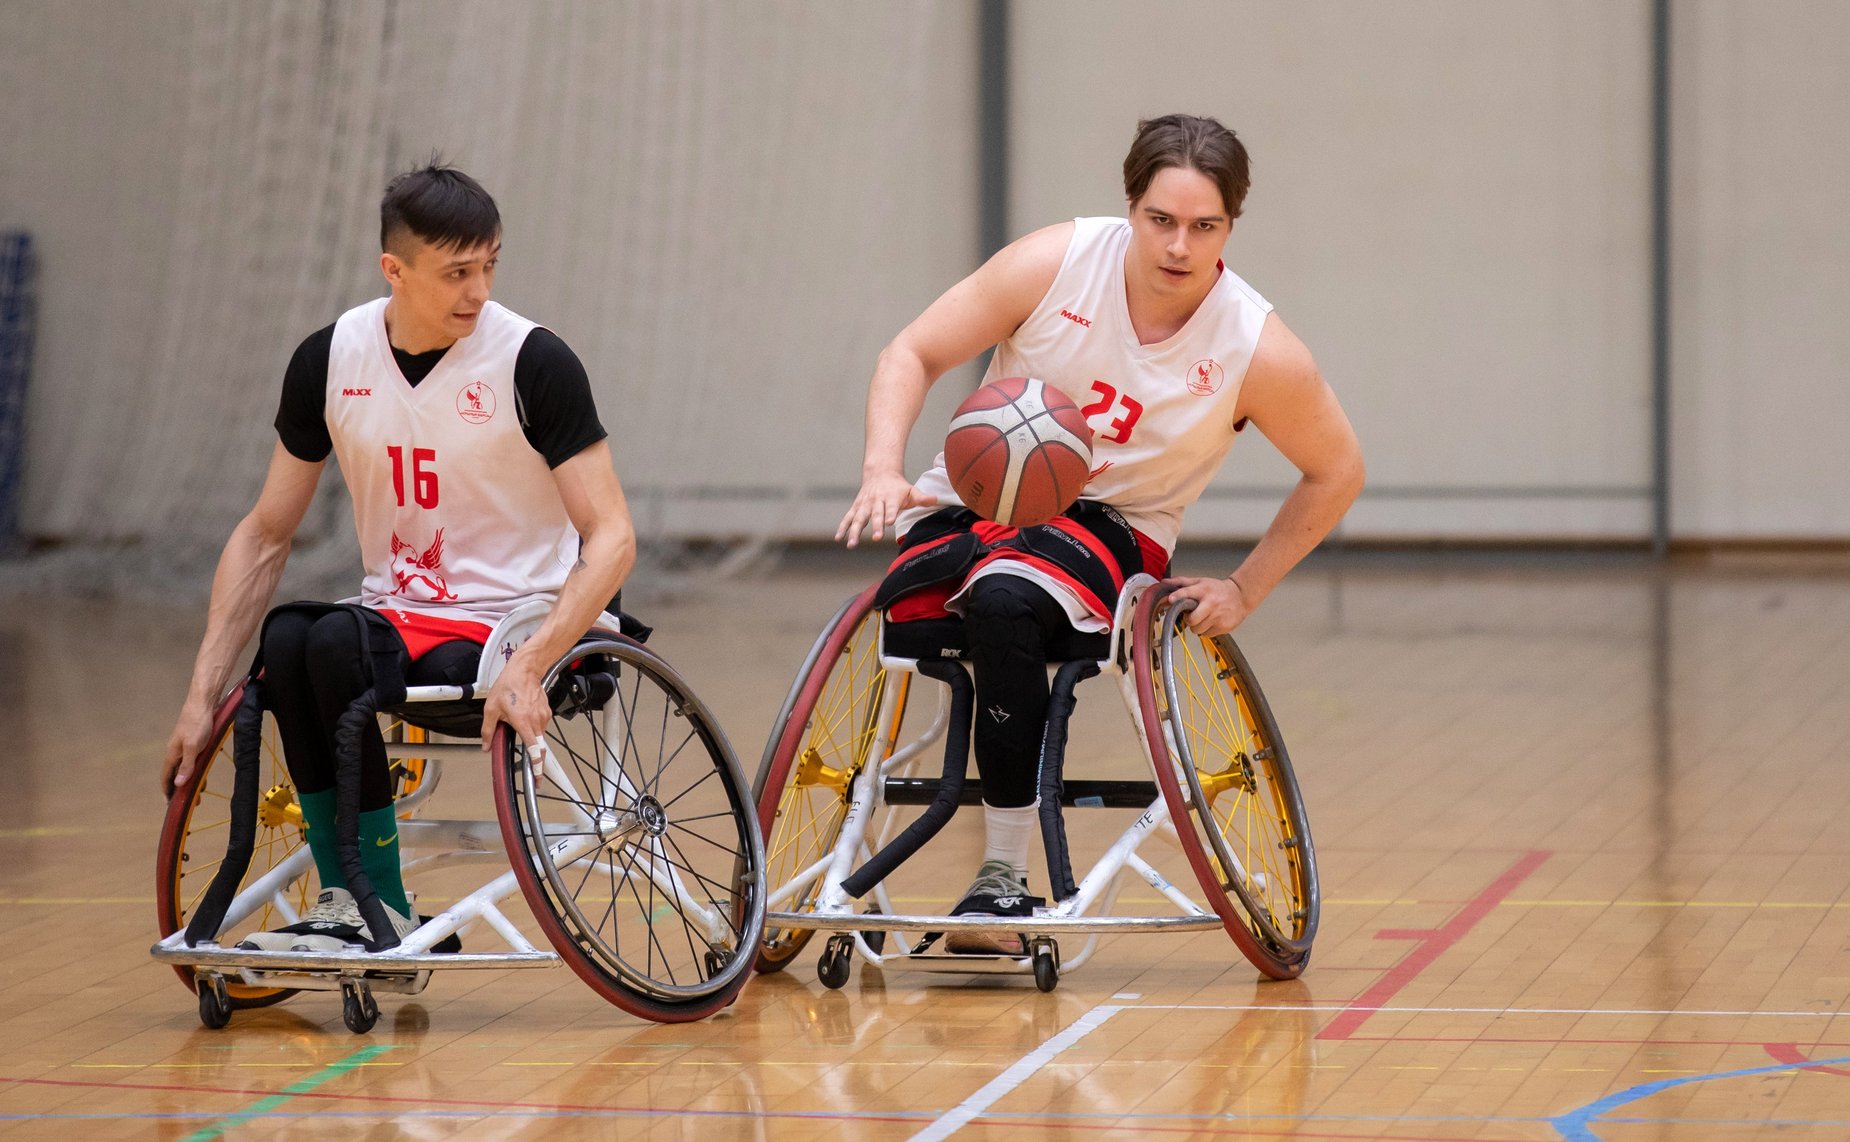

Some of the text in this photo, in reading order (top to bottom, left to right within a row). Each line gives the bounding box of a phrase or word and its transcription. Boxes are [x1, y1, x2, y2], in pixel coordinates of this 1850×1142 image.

[1060, 309, 1092, 328] MAXX
[1081, 380, 1143, 444] 23
[387, 445, 439, 510] 16
